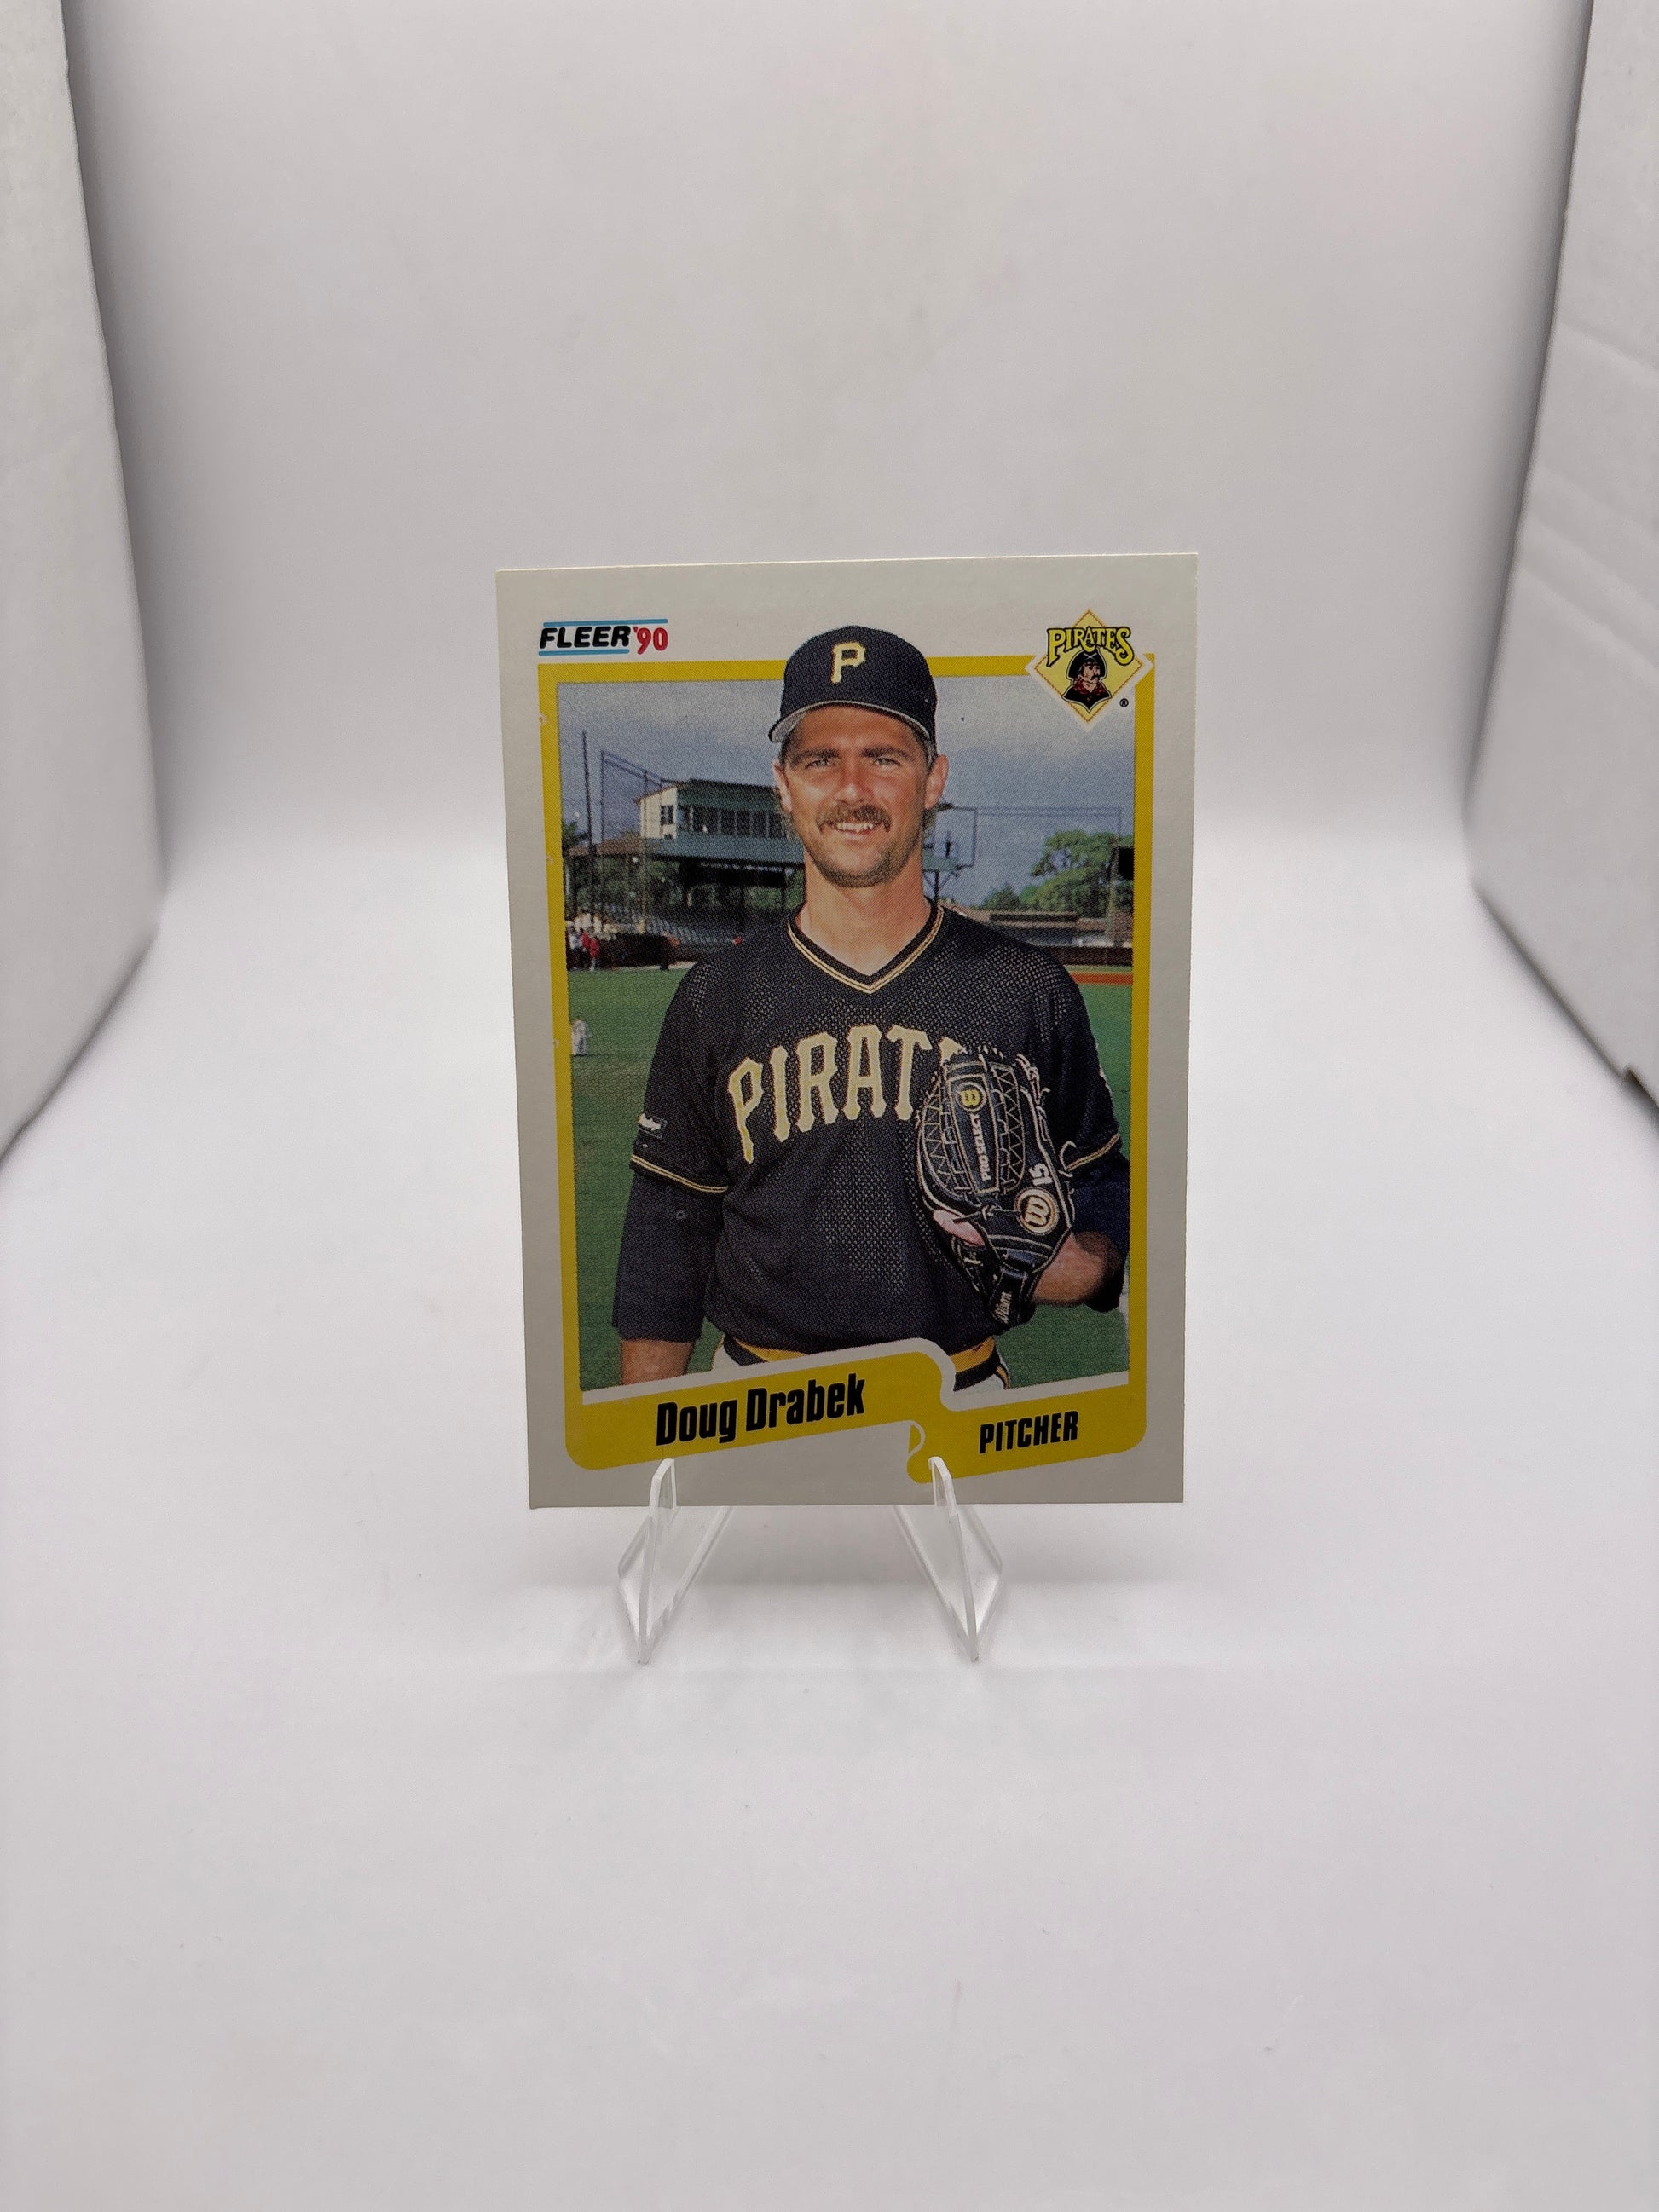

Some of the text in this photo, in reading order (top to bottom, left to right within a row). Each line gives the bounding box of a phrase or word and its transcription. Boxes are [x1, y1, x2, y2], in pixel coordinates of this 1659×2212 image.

[539, 625, 668, 656] FLEER '90
[1046, 626, 1136, 667] PIRATES
[830, 641, 866, 684] P
[727, 1025, 968, 1164] PIRAT
[978, 1153, 991, 1181] PRO
[656, 1372, 865, 1446] Doug Drabek
[979, 1410, 1078, 1454] PITCHER
